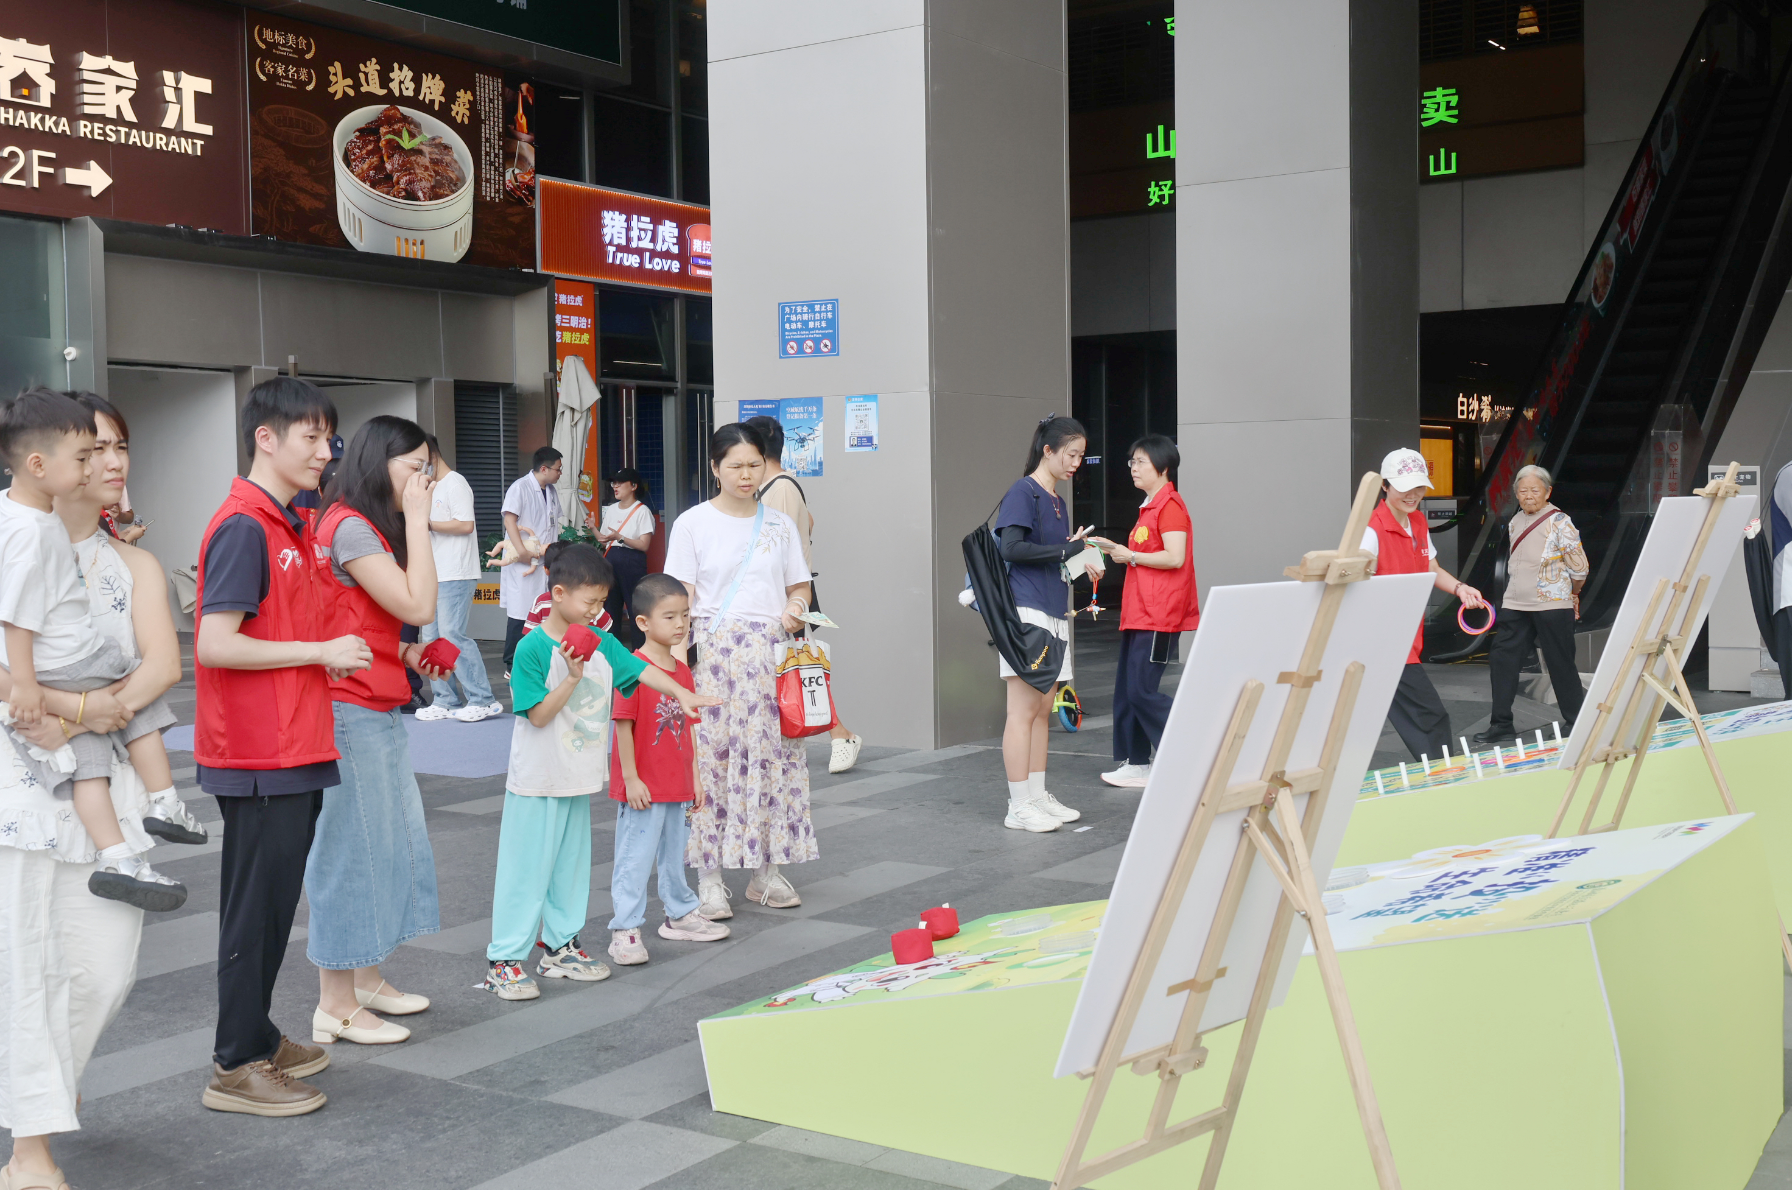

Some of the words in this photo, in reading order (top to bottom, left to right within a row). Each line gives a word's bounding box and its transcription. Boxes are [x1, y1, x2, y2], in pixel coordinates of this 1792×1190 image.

[262, 28, 307, 50] 地标美食
[263, 60, 309, 82] 客家名菜
[327, 57, 474, 125] 头道招牌菜
[1420, 86, 1460, 128] 卖
[0, 107, 71, 136] HAKKA
[79, 120, 205, 156] RESTAURANT
[0, 145, 57, 189] 2F
[1428, 147, 1457, 177] 山
[601, 210, 680, 255] 猪拉虎
[606, 246, 640, 267] True
[644, 252, 681, 273] Love
[800, 675, 824, 688] KFC
